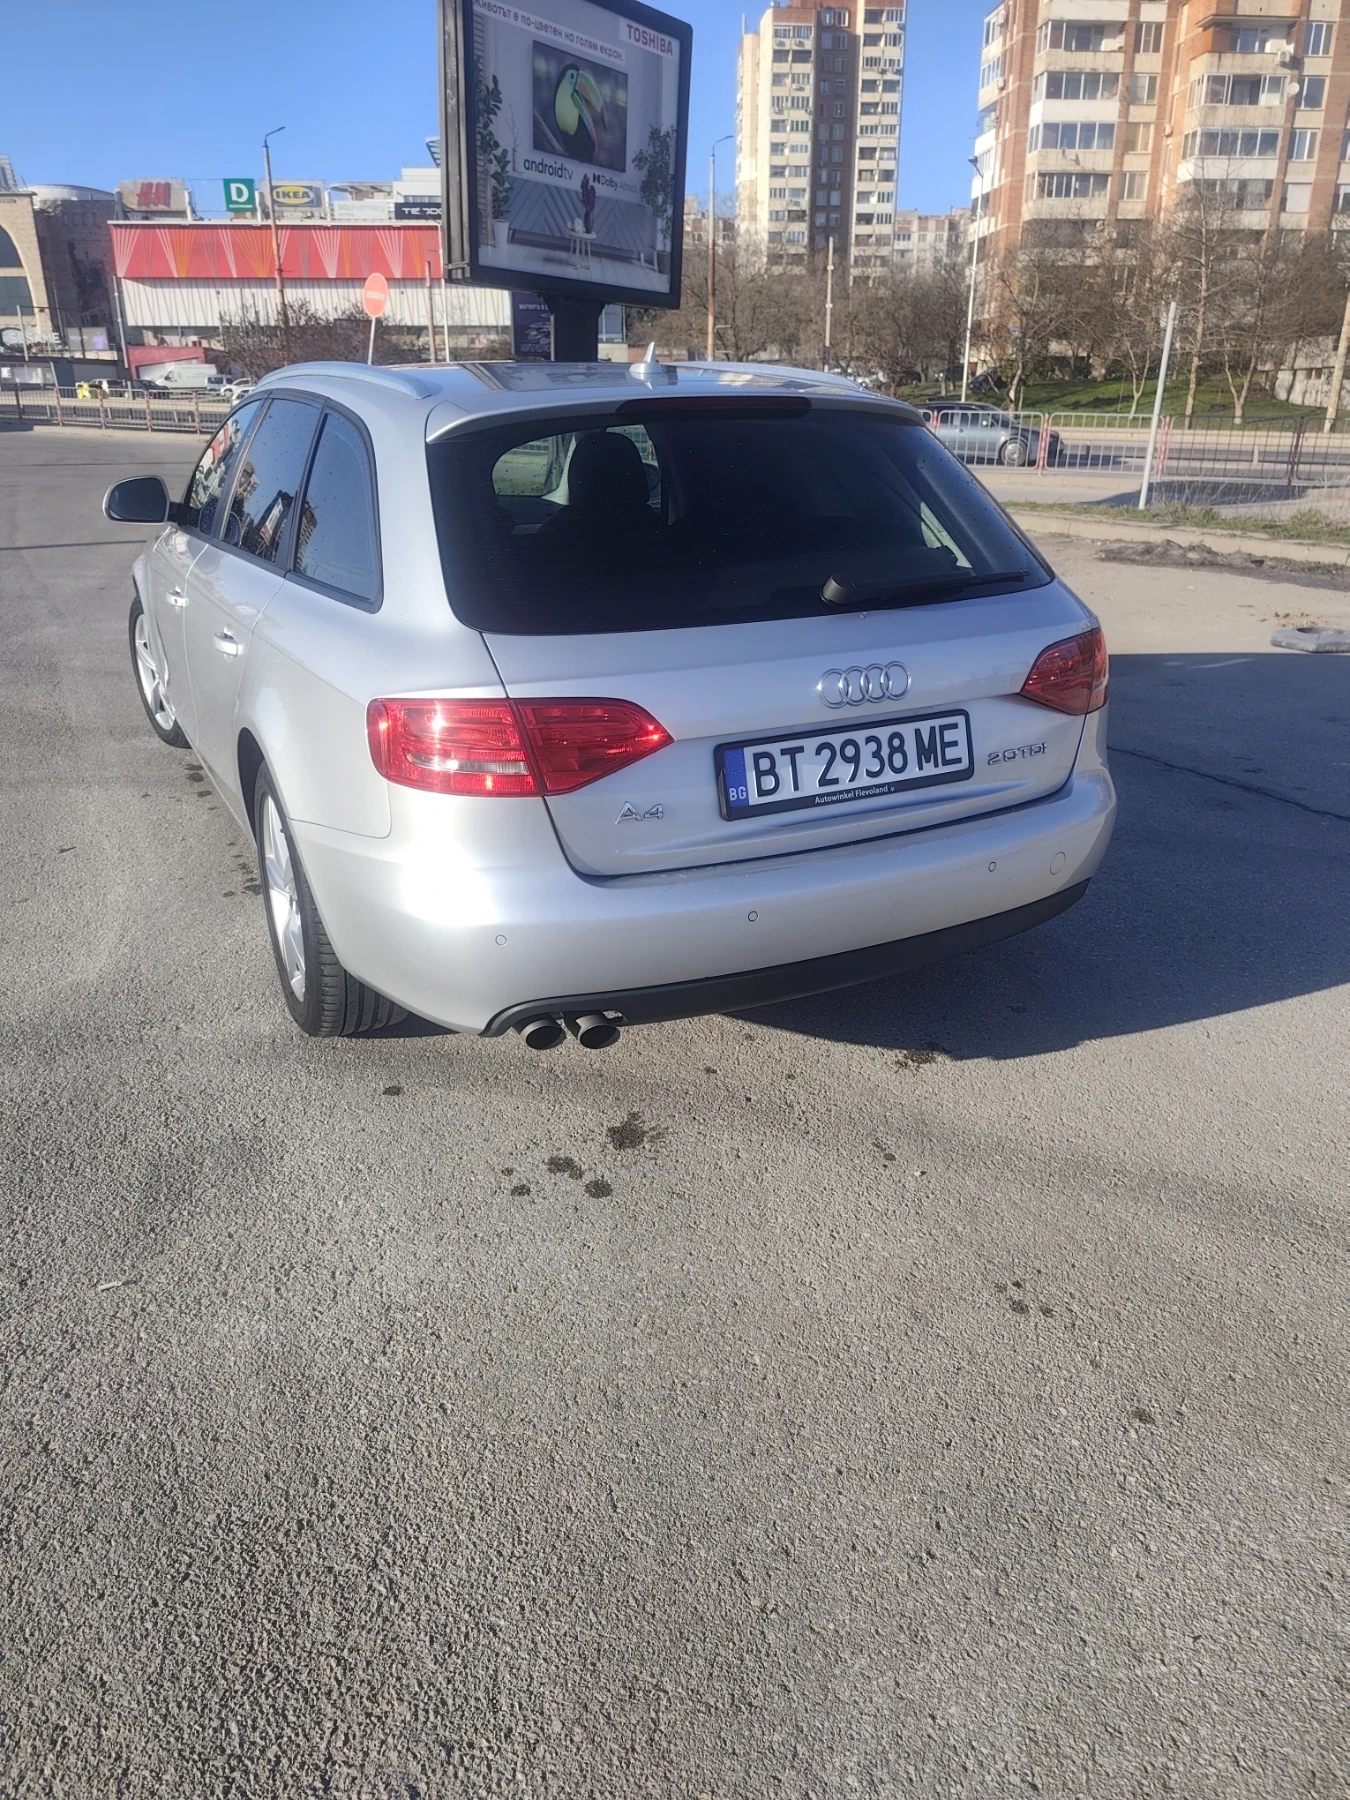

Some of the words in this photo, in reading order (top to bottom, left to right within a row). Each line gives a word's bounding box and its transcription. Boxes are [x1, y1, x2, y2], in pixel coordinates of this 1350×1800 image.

[513, 12, 519, 22] е
[521, 14, 563, 38] по-цветен
[564, 31, 575, 43] на
[576, 35, 599, 52] голям
[626, 23, 674, 57] TOSHIBA
[230, 183, 250, 202] D
[275, 189, 310, 199] IKEA
[752, 746, 805, 798] BT
[814, 731, 909, 788] 2938
[914, 722, 963, 771] ME
[729, 786, 747, 801] BG
[814, 783, 855, 805] Autowinkel
[614, 800, 665, 825] A4
